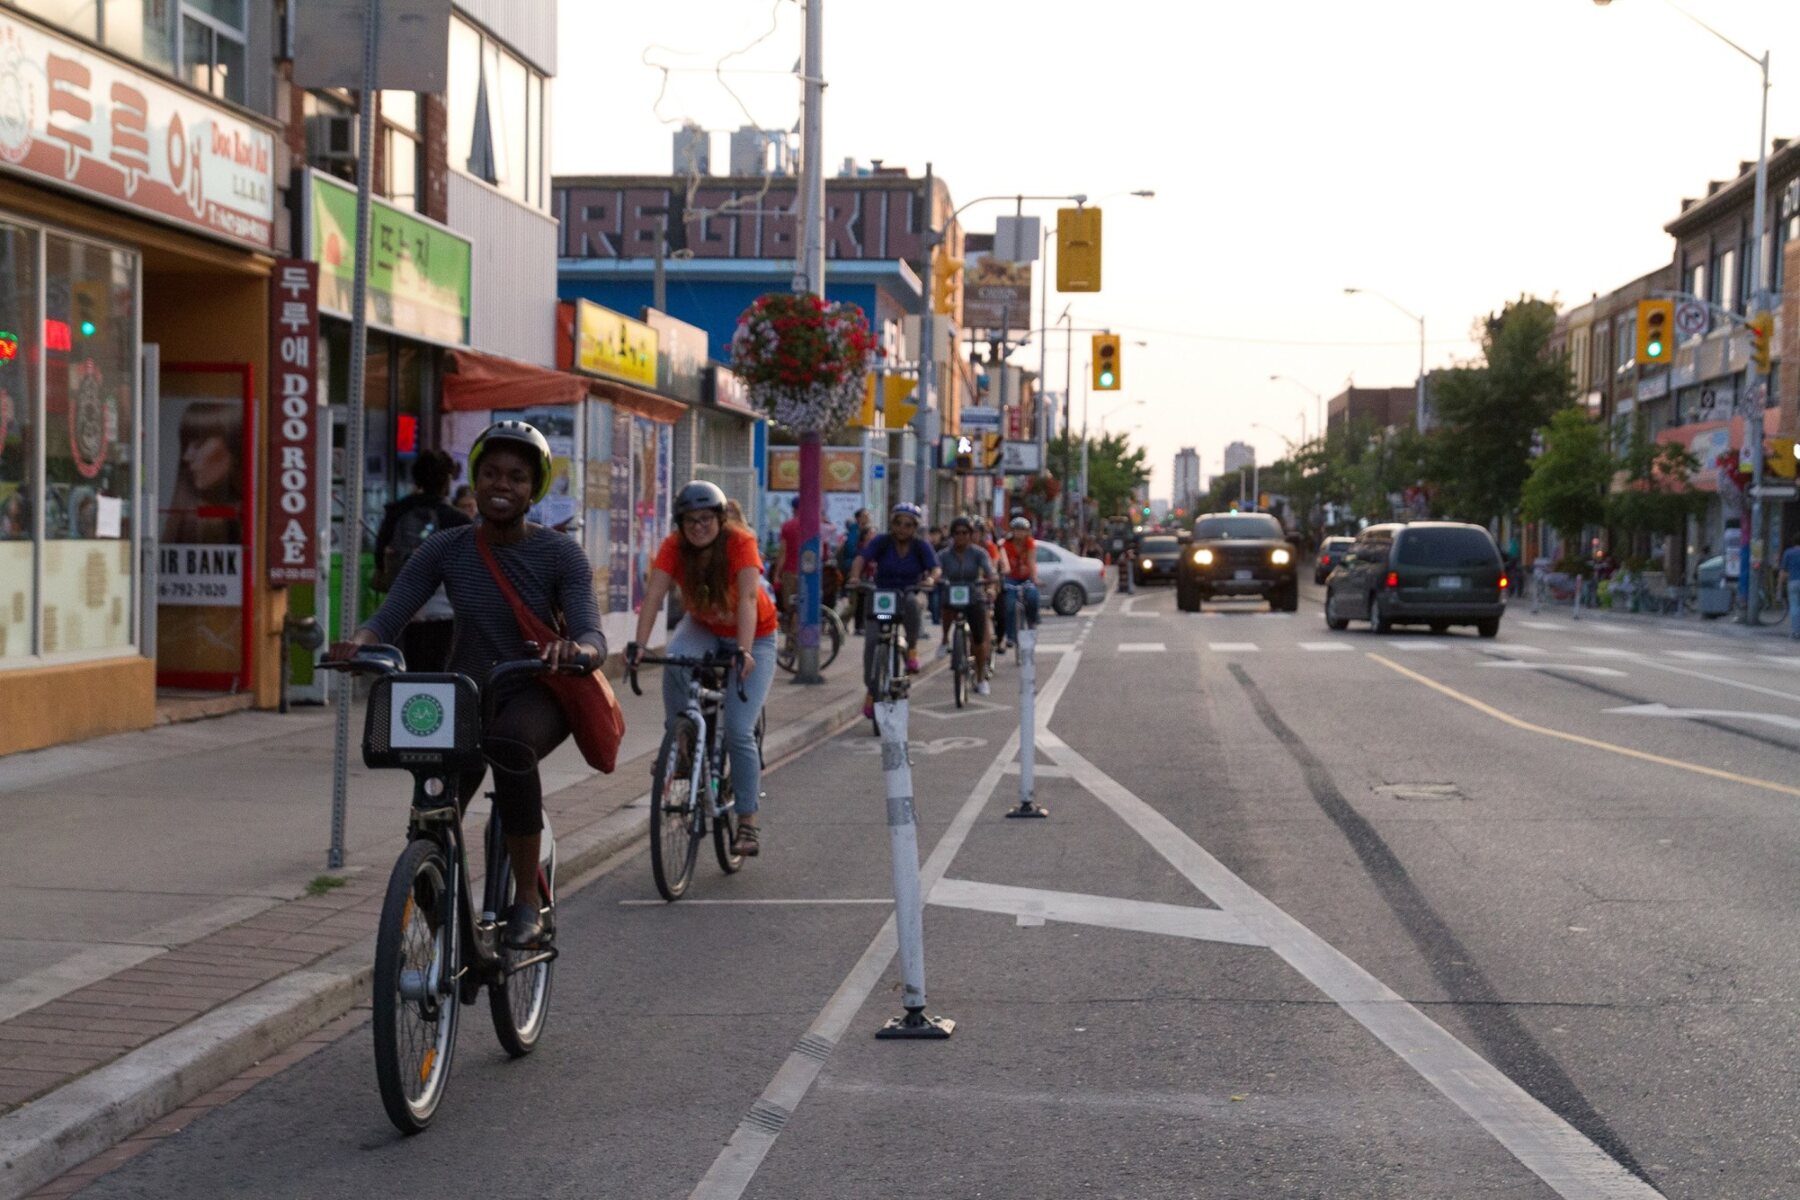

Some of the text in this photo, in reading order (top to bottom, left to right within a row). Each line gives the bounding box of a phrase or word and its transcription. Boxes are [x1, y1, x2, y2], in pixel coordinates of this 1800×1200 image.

[46, 52, 207, 217] 두루애
[280, 267, 310, 368] 두루애
[185, 549, 237, 575] BANK
